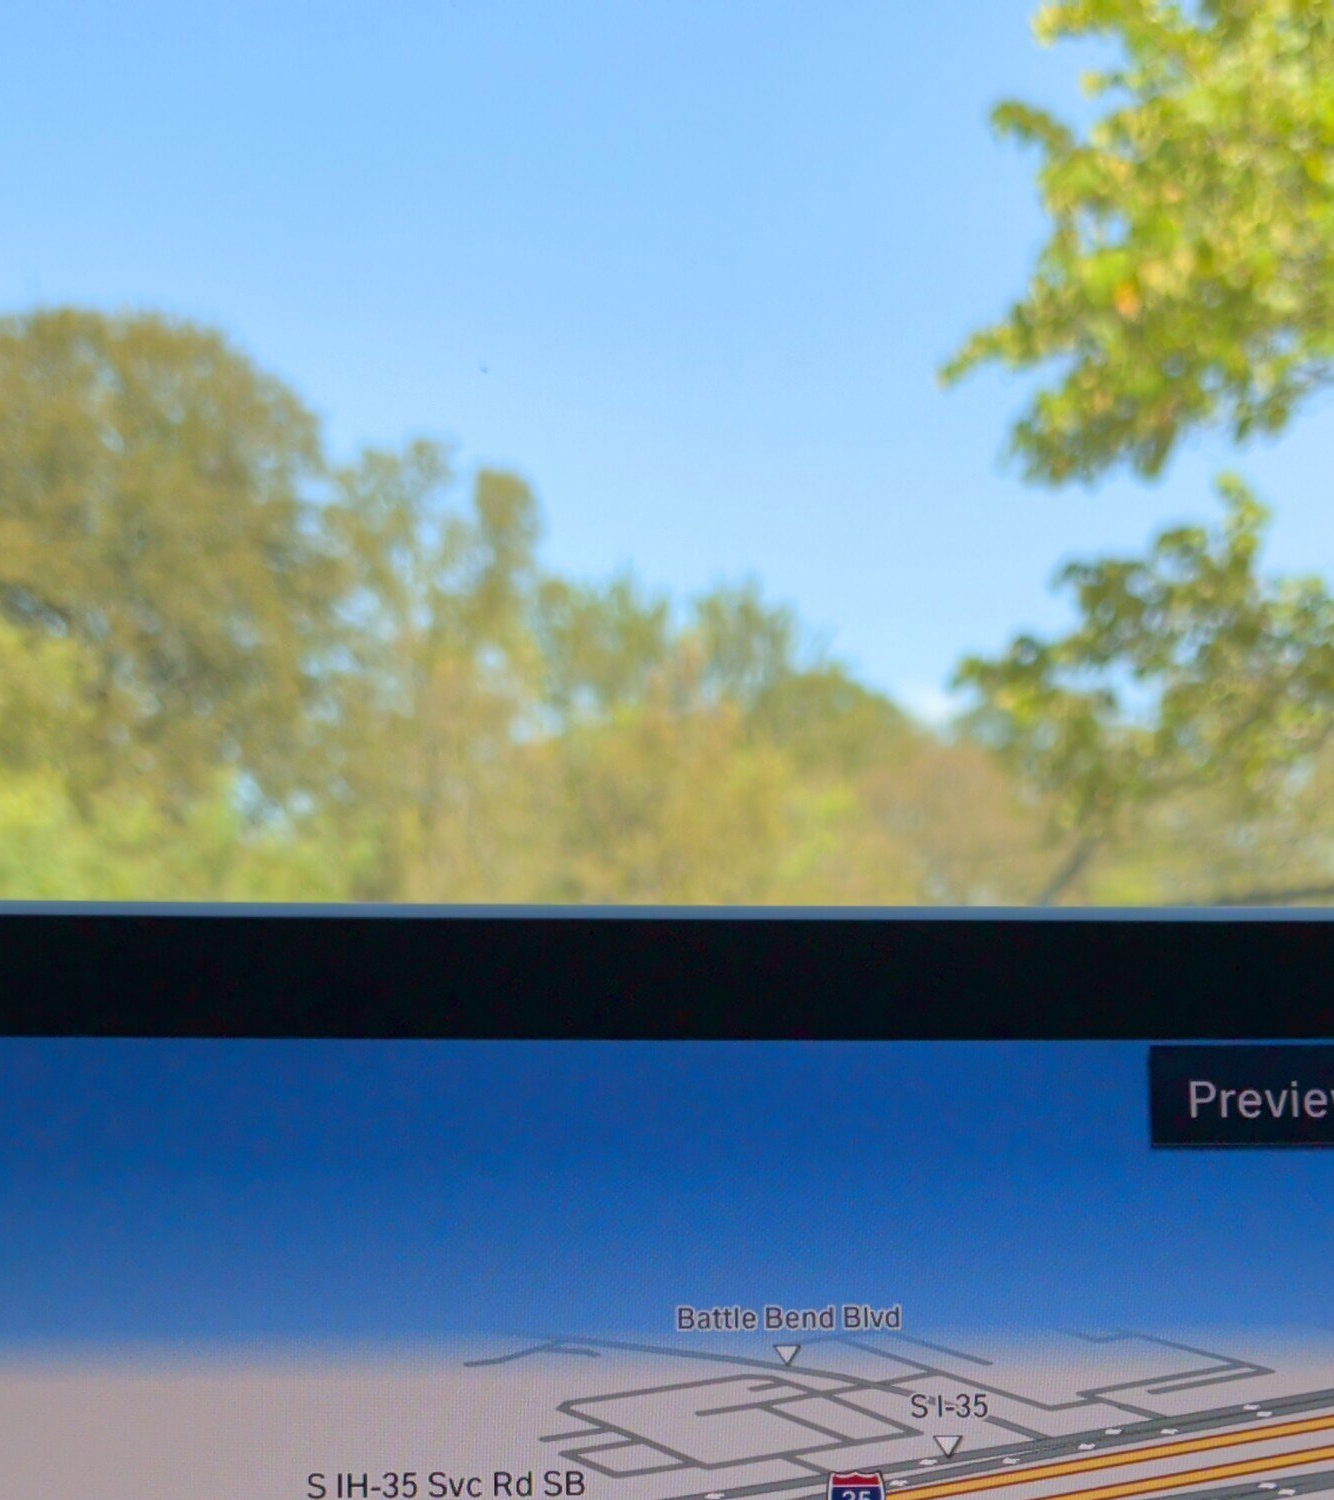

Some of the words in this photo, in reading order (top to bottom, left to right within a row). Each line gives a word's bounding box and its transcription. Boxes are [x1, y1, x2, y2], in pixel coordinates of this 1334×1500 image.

[677, 1306, 757, 1330] Battle
[765, 1306, 835, 1330] Bend
[843, 1304, 902, 1329] Blvd
[910, 1394, 929, 1419] S
[938, 1393, 989, 1418] I-35
[307, 1472, 326, 1499] S
[336, 1472, 418, 1499] IH-35
[427, 1471, 483, 1498] Svc
[493, 1470, 533, 1497] Rd
[543, 1470, 586, 1496] SB
